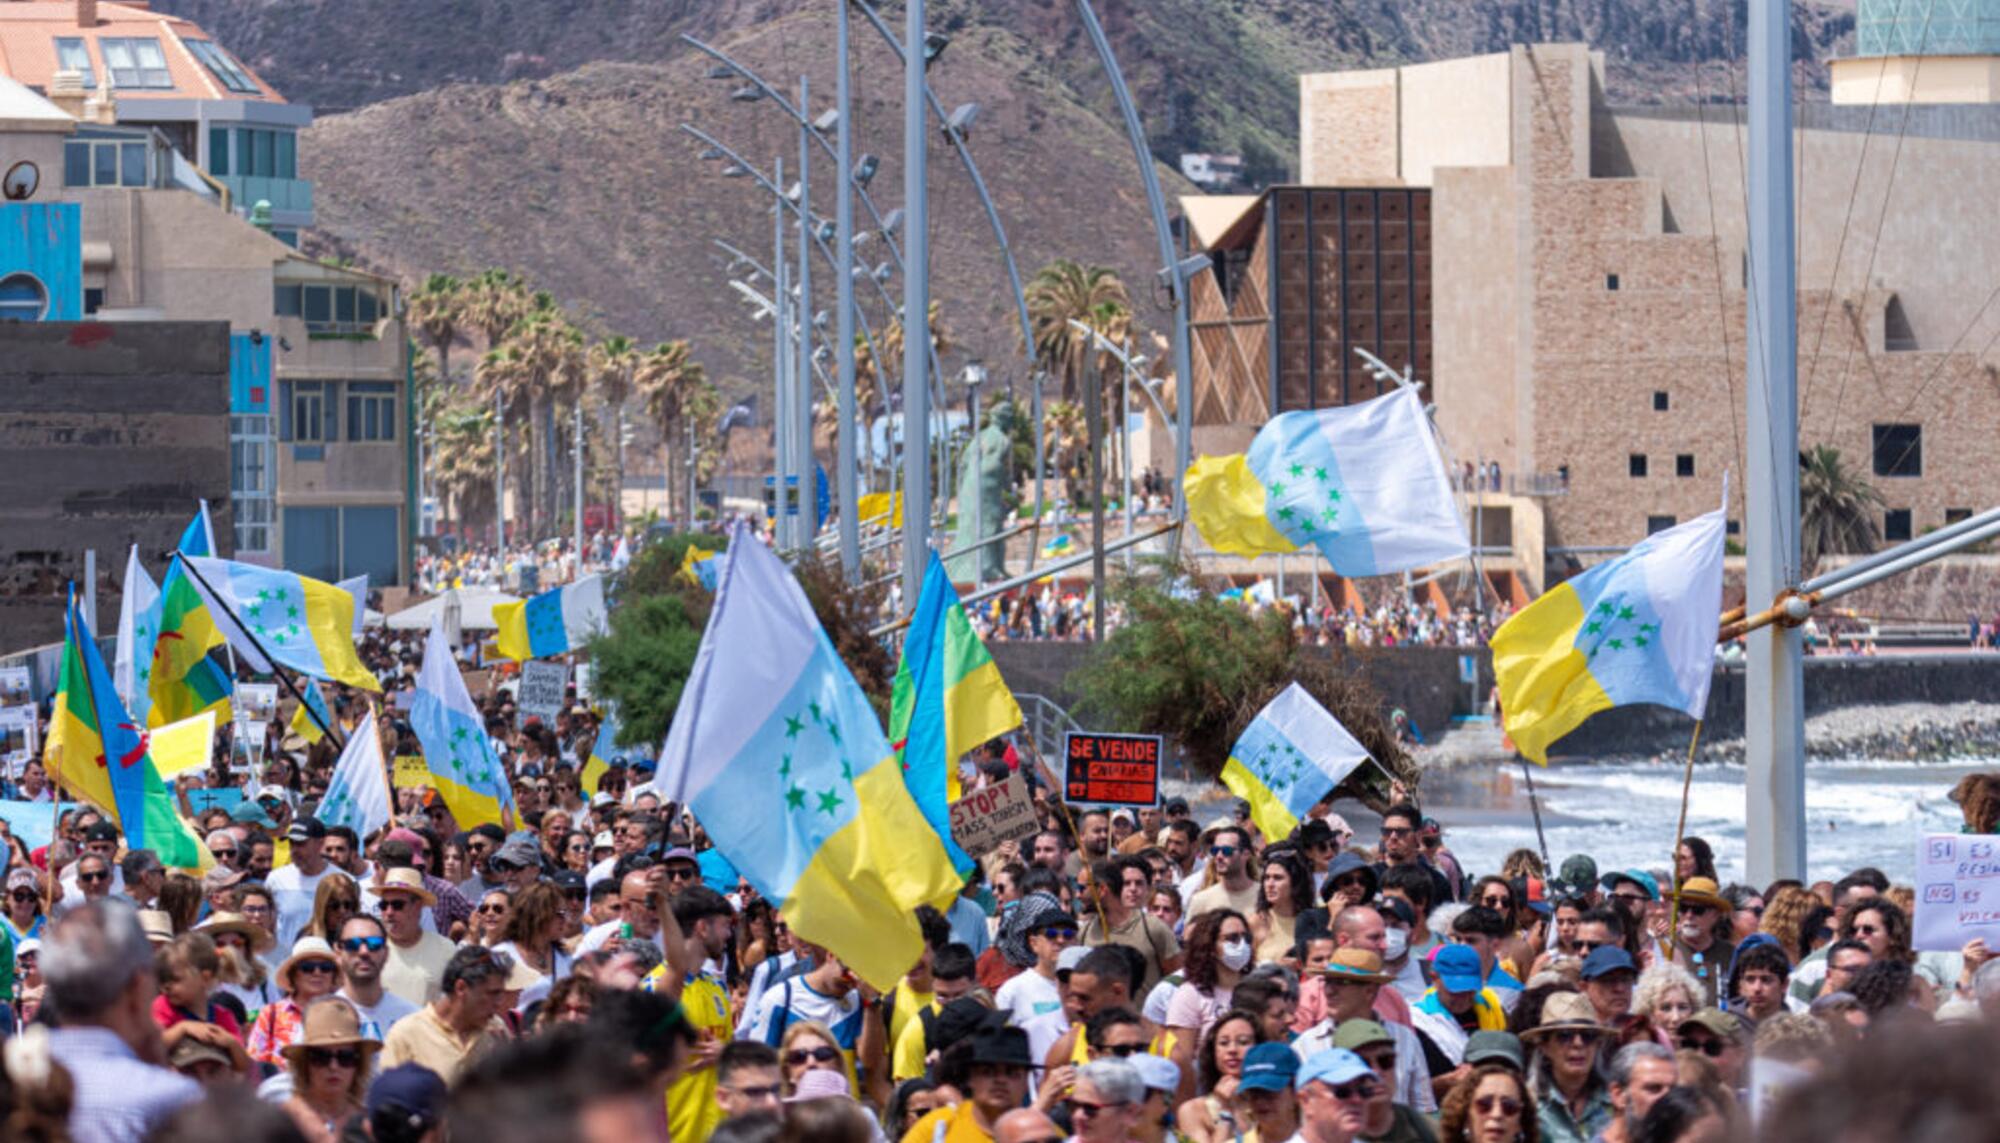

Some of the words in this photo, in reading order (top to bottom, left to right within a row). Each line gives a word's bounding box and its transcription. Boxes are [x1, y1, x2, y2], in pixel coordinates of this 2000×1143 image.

[1070, 738, 1093, 758] SE
[1098, 739, 1156, 761] VENDE
[951, 817, 988, 841] MASS
